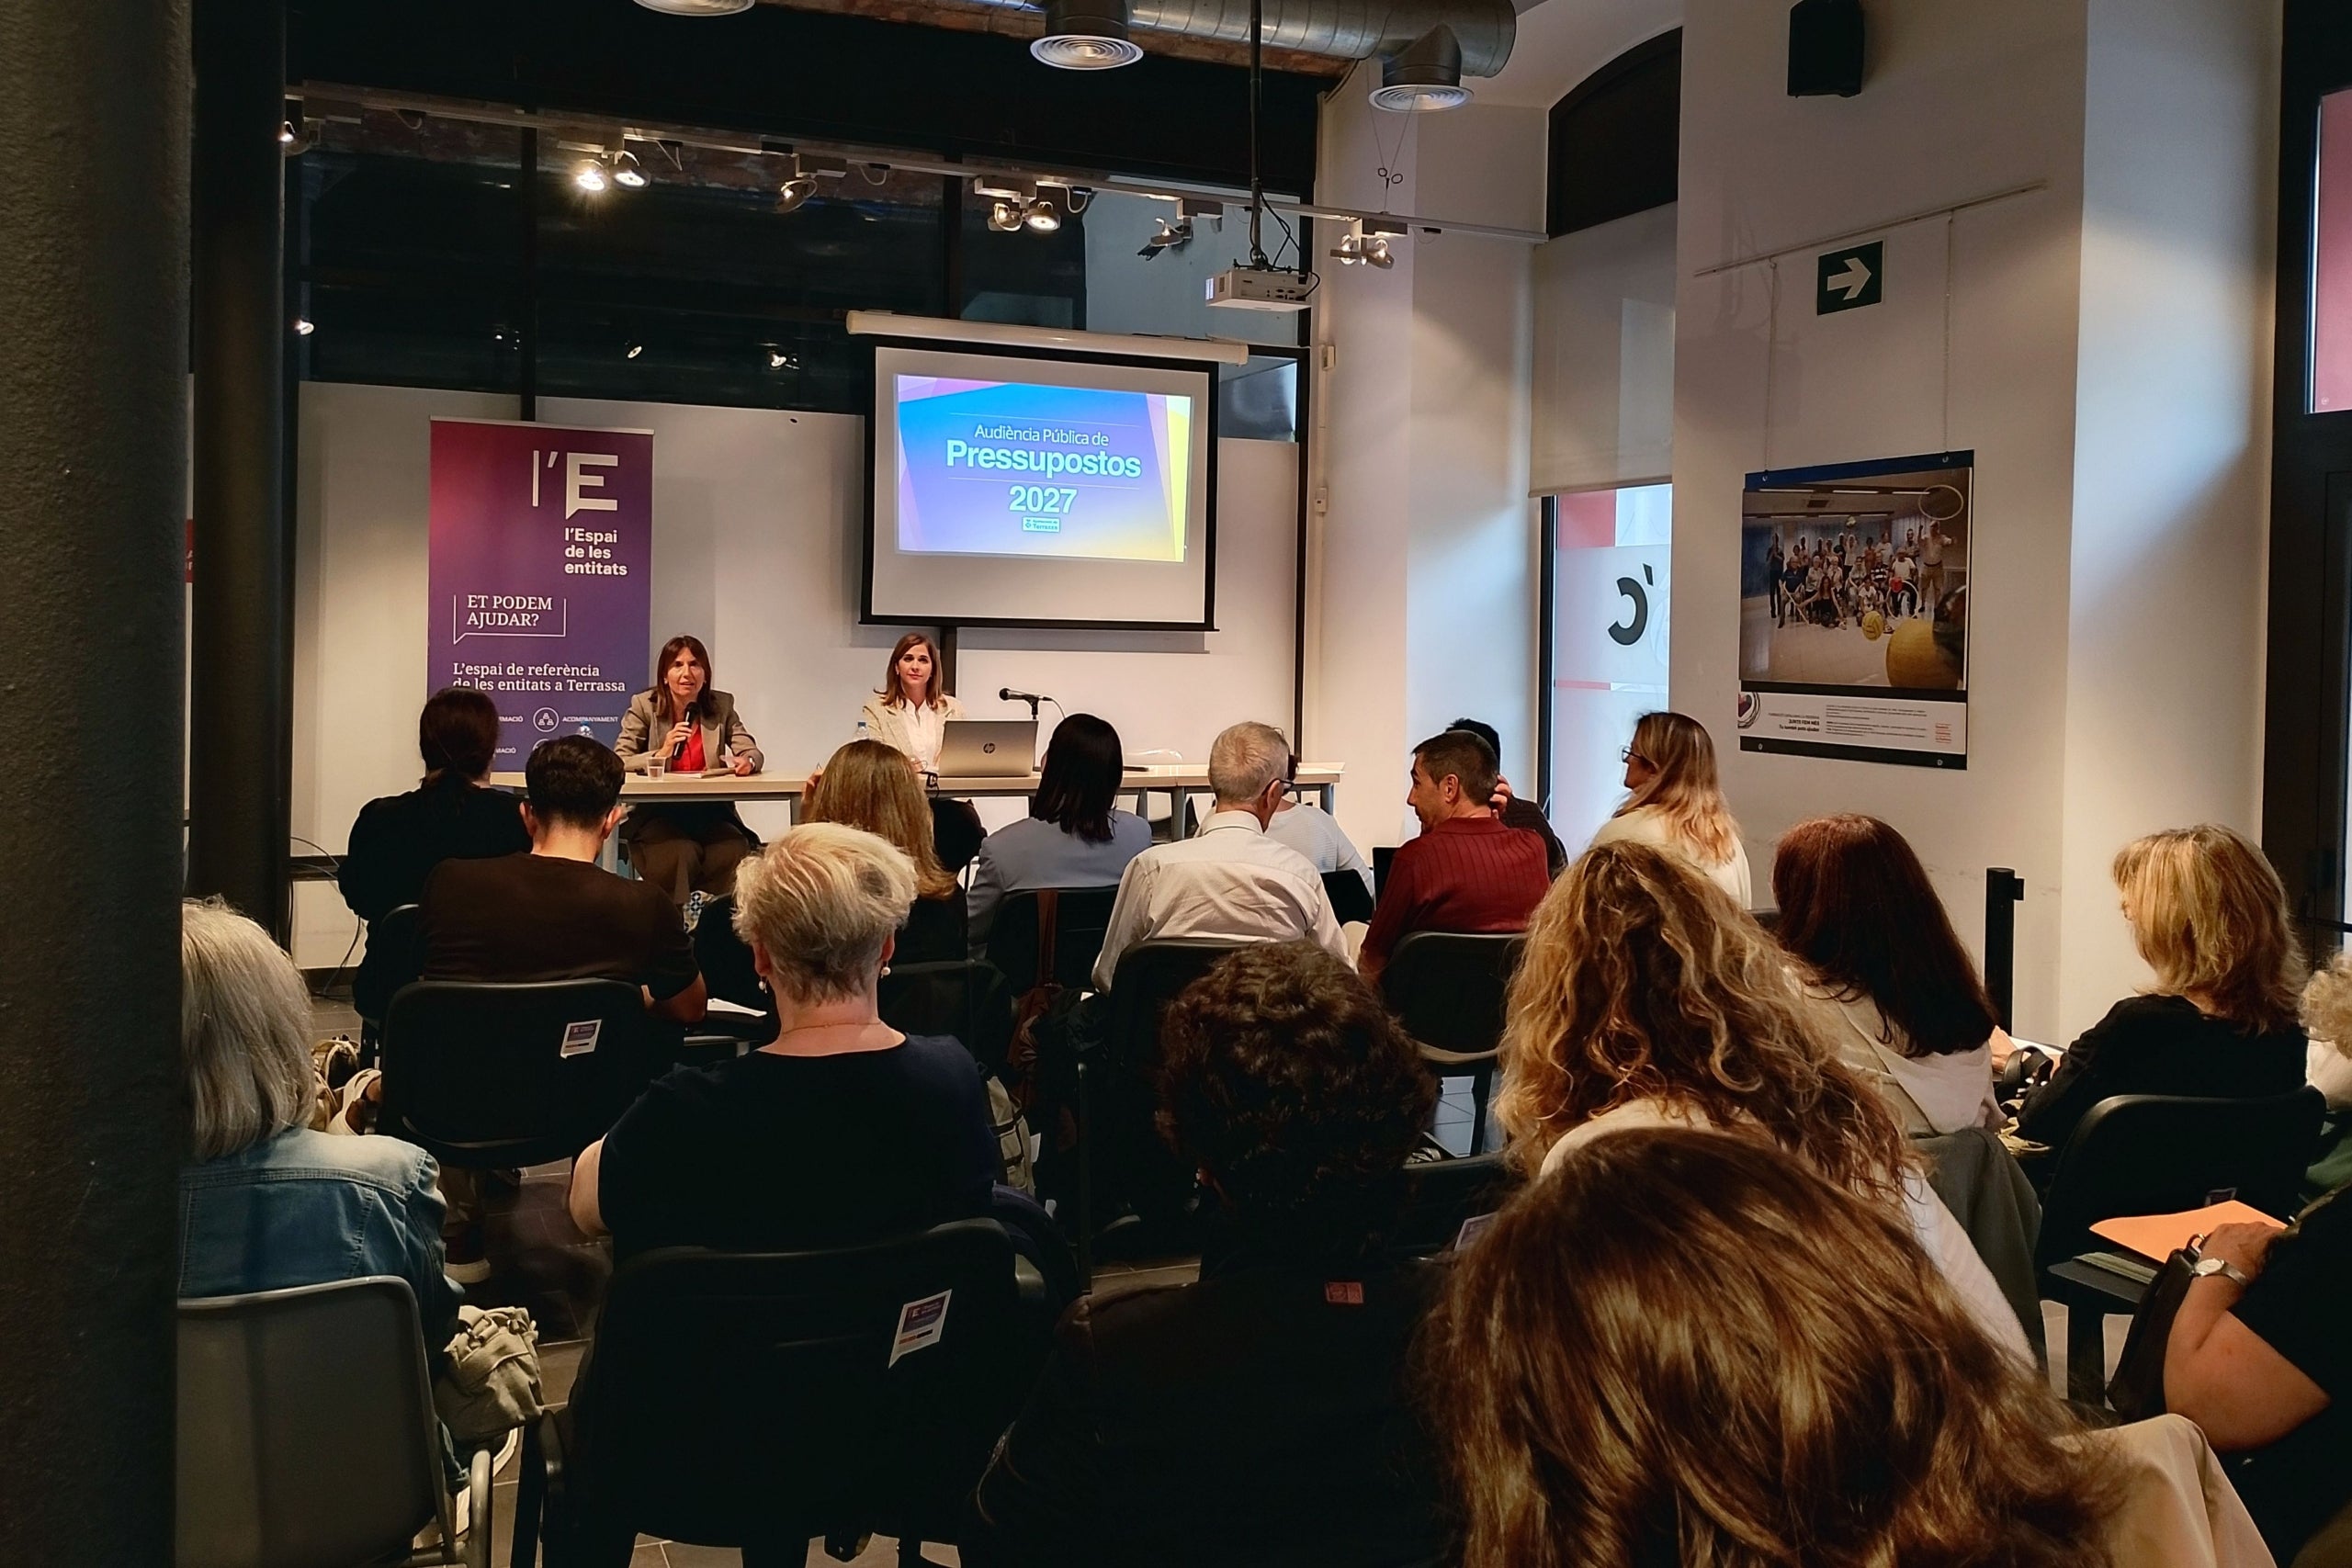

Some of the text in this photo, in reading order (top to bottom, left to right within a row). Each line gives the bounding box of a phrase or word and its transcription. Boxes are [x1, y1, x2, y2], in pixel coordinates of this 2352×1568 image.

[974, 423, 1110, 446] Audiència Pública de
[946, 439, 1142, 479] Pressupostos
[1009, 485, 1078, 514] 2027
[565, 527, 617, 546] l'Espai
[565, 544, 612, 559] de les
[564, 560, 628, 576] entitats
[467, 594, 553, 611] ET PODEM
[466, 611, 540, 629] AJUDAR?
[453, 662, 600, 678] L'espai de referència
[474, 678, 494, 691] les
[497, 679, 551, 691] entitats
[554, 682, 563, 692] a
[566, 680, 626, 692] Terrassa
